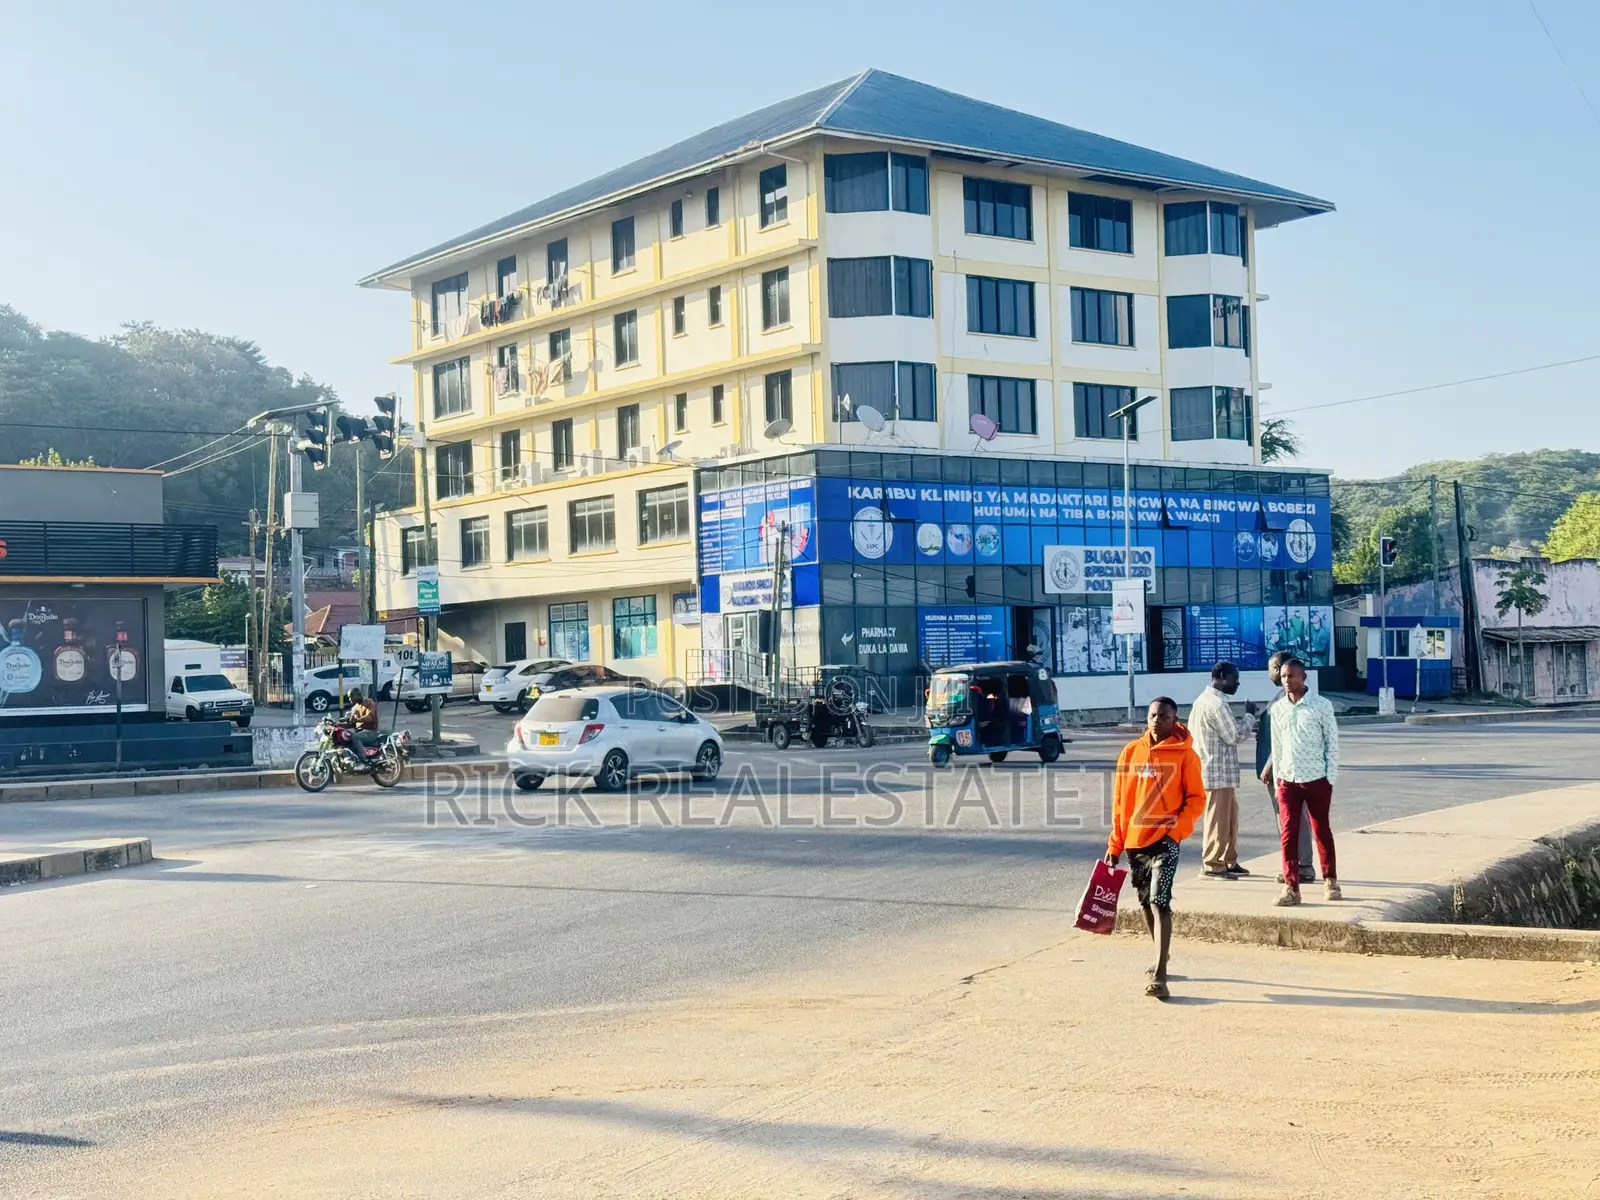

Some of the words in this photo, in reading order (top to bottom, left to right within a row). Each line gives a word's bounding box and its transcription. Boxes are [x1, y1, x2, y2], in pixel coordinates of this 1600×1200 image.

[848, 486, 916, 500] KARIBU
[921, 489, 982, 502] KLINIKI
[986, 491, 1009, 504] YA
[1013, 492, 1107, 507] MADAKTARI
[1180, 497, 1199, 510] NA
[1203, 500, 1265, 513] BINGWA
[1268, 501, 1316, 515] BOBEZI
[974, 506, 1036, 518] HUDUMA
[1039, 508, 1058, 519] NA
[1062, 508, 1094, 519] TIBA
[1096, 509, 1134, 521] BORA
[1137, 511, 1173, 522] KWA
[1084, 565, 1152, 577] SPECIALZED
[861, 627, 896, 638] PHARMACY
[397, 649, 414, 660] 10t
[858, 644, 877, 655] DUKA
[878, 643, 888, 654] LA
[890, 643, 908, 654] DAWA
